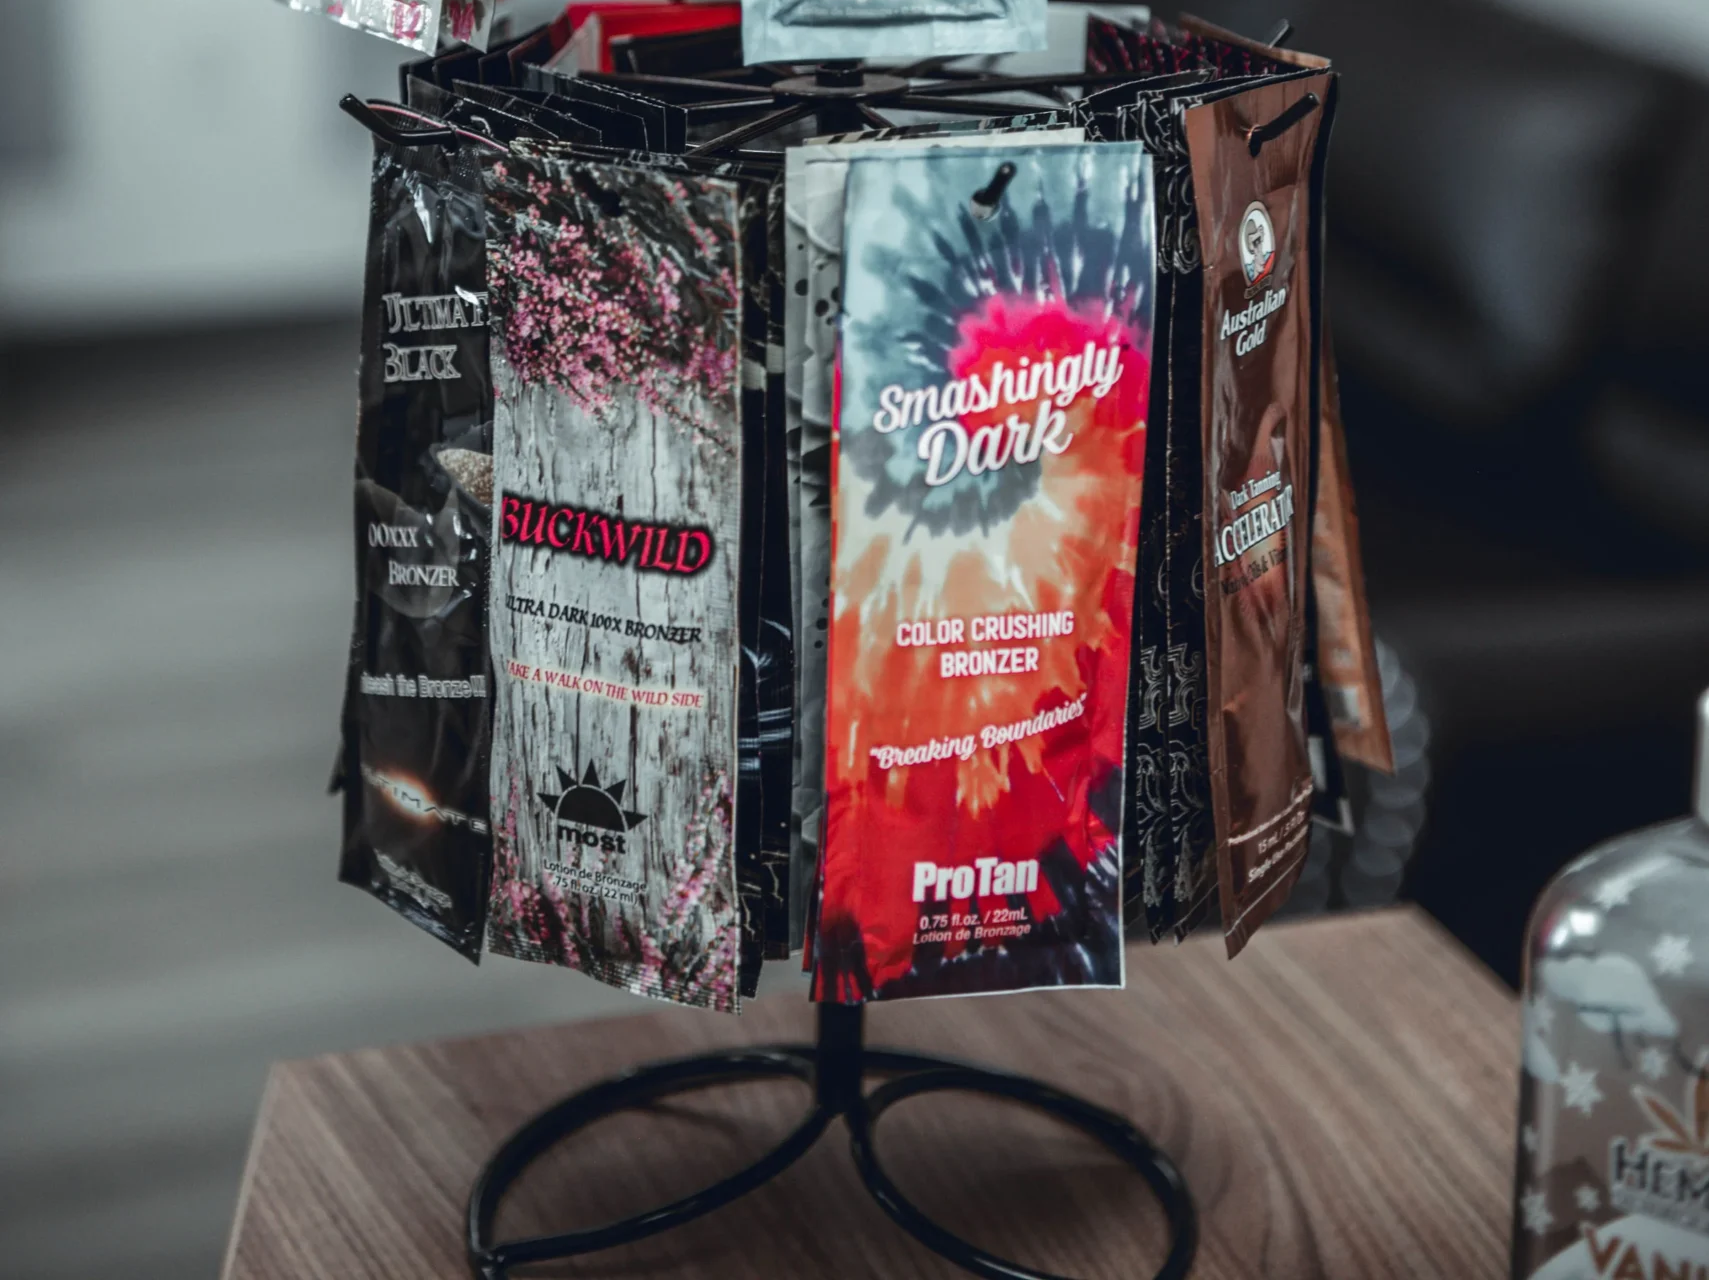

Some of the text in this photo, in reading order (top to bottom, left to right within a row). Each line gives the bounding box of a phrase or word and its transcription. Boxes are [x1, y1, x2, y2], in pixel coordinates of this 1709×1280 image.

[382, 291, 491, 334] ULTIMAT
[1220, 287, 1287, 341] Australian
[1235, 319, 1268, 357] Gold
[383, 343, 462, 383] BLACK
[872, 341, 1125, 435] Smashingly
[917, 399, 1073, 487] Dark
[502, 496, 712, 574] BUCKWILD
[388, 560, 460, 587] BRONZER
[547, 602, 589, 628] DARK
[590, 612, 622, 633] 100X
[624, 619, 702, 645] BRONZER
[896, 610, 1075, 646] COLOR CRUSHING
[940, 646, 1039, 678] BRONZER
[531, 667, 542, 682] A
[544, 670, 581, 690] WALK
[583, 679, 604, 694] ON
[605, 682, 629, 701] THE
[631, 689, 668, 706] WILD
[671, 693, 704, 708] SIDE
[556, 824, 627, 855] most
[543, 858, 648, 894] Lotion de Bronzage
[912, 856, 1039, 902] ProTan
[912, 923, 1032, 946] Lotion de Bronzage
[919, 913, 949, 931] 0.75
[992, 906, 1029, 924] 22mL
